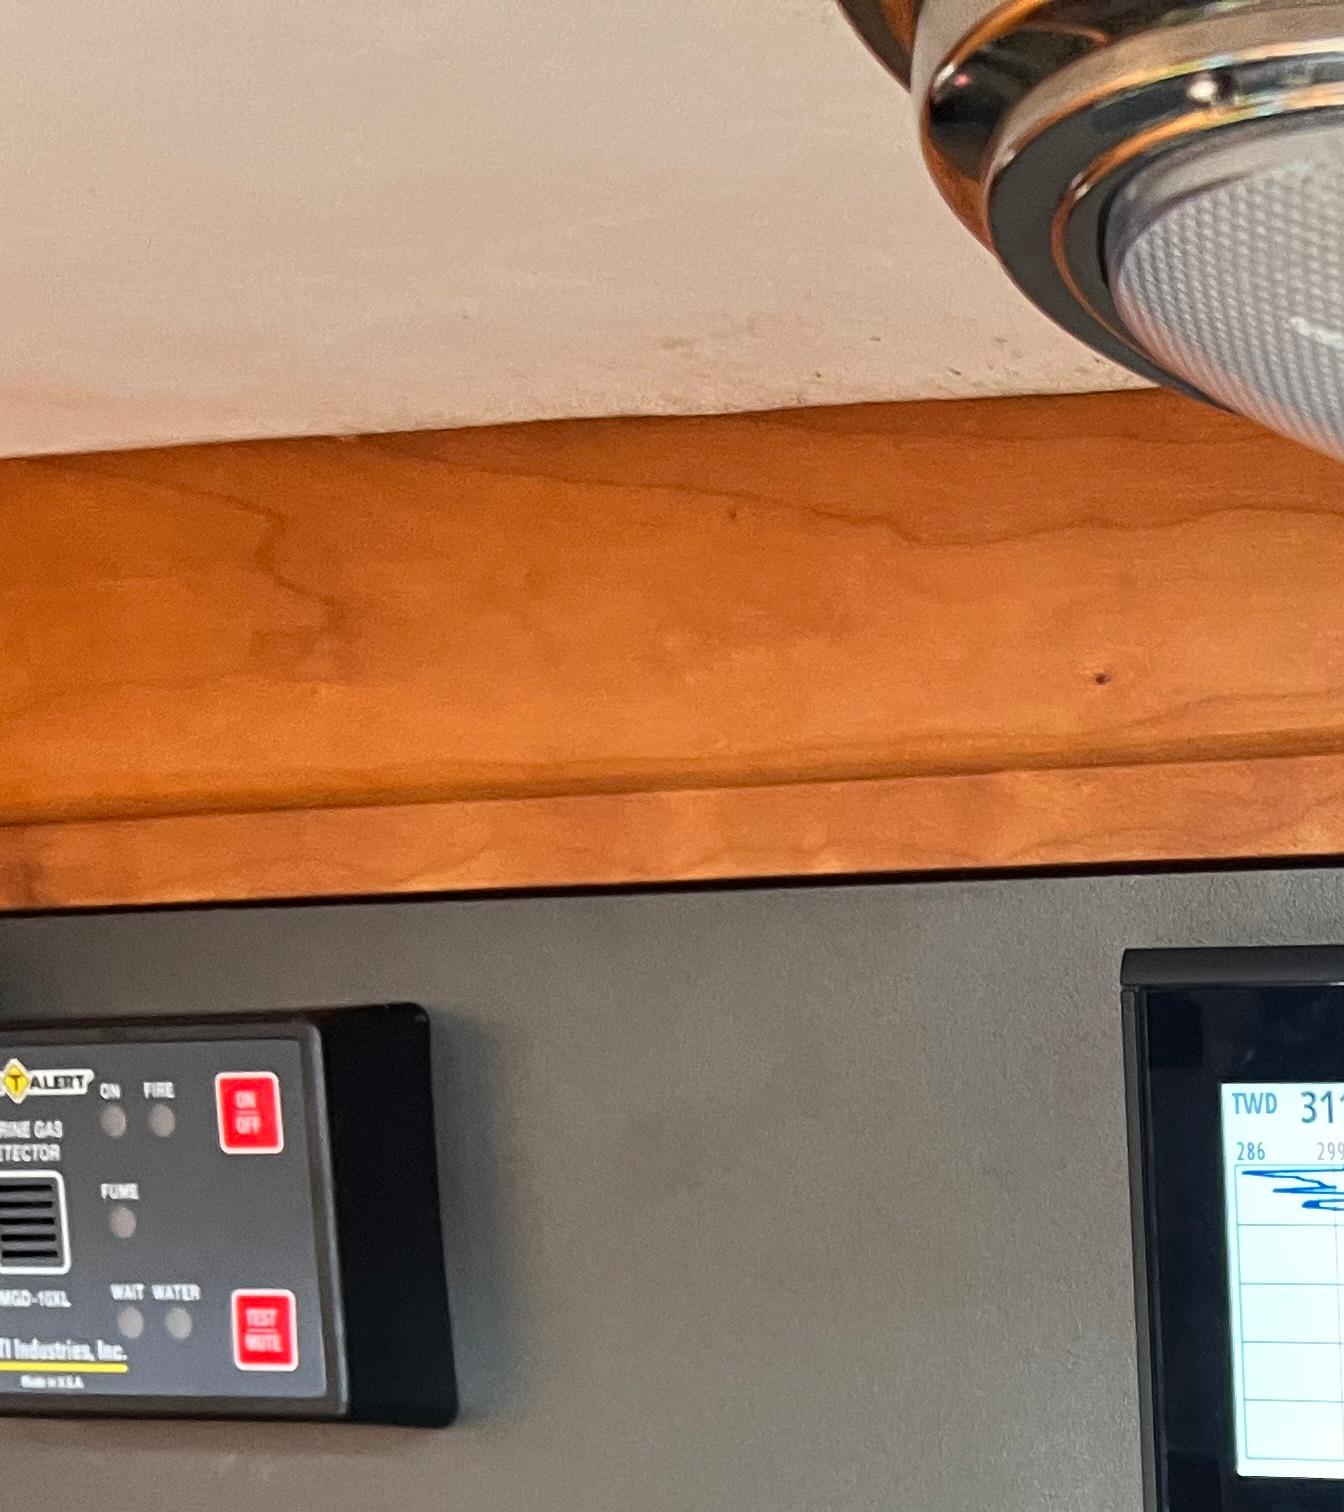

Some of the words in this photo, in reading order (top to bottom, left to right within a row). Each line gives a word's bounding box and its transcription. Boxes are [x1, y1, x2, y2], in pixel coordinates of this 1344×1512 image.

[100, 1083, 120, 1099] ON
[235, 1090, 257, 1108] ON
[1232, 1092, 1277, 1114] TWD
[34, 1120, 63, 1138] GAS
[235, 1116, 261, 1135] OFF
[1236, 1142, 1265, 1161] 286
[110, 1283, 145, 1300] WAIT
[151, 1284, 200, 1301] WATER
[97, 1339, 128, 1361] Inc.
